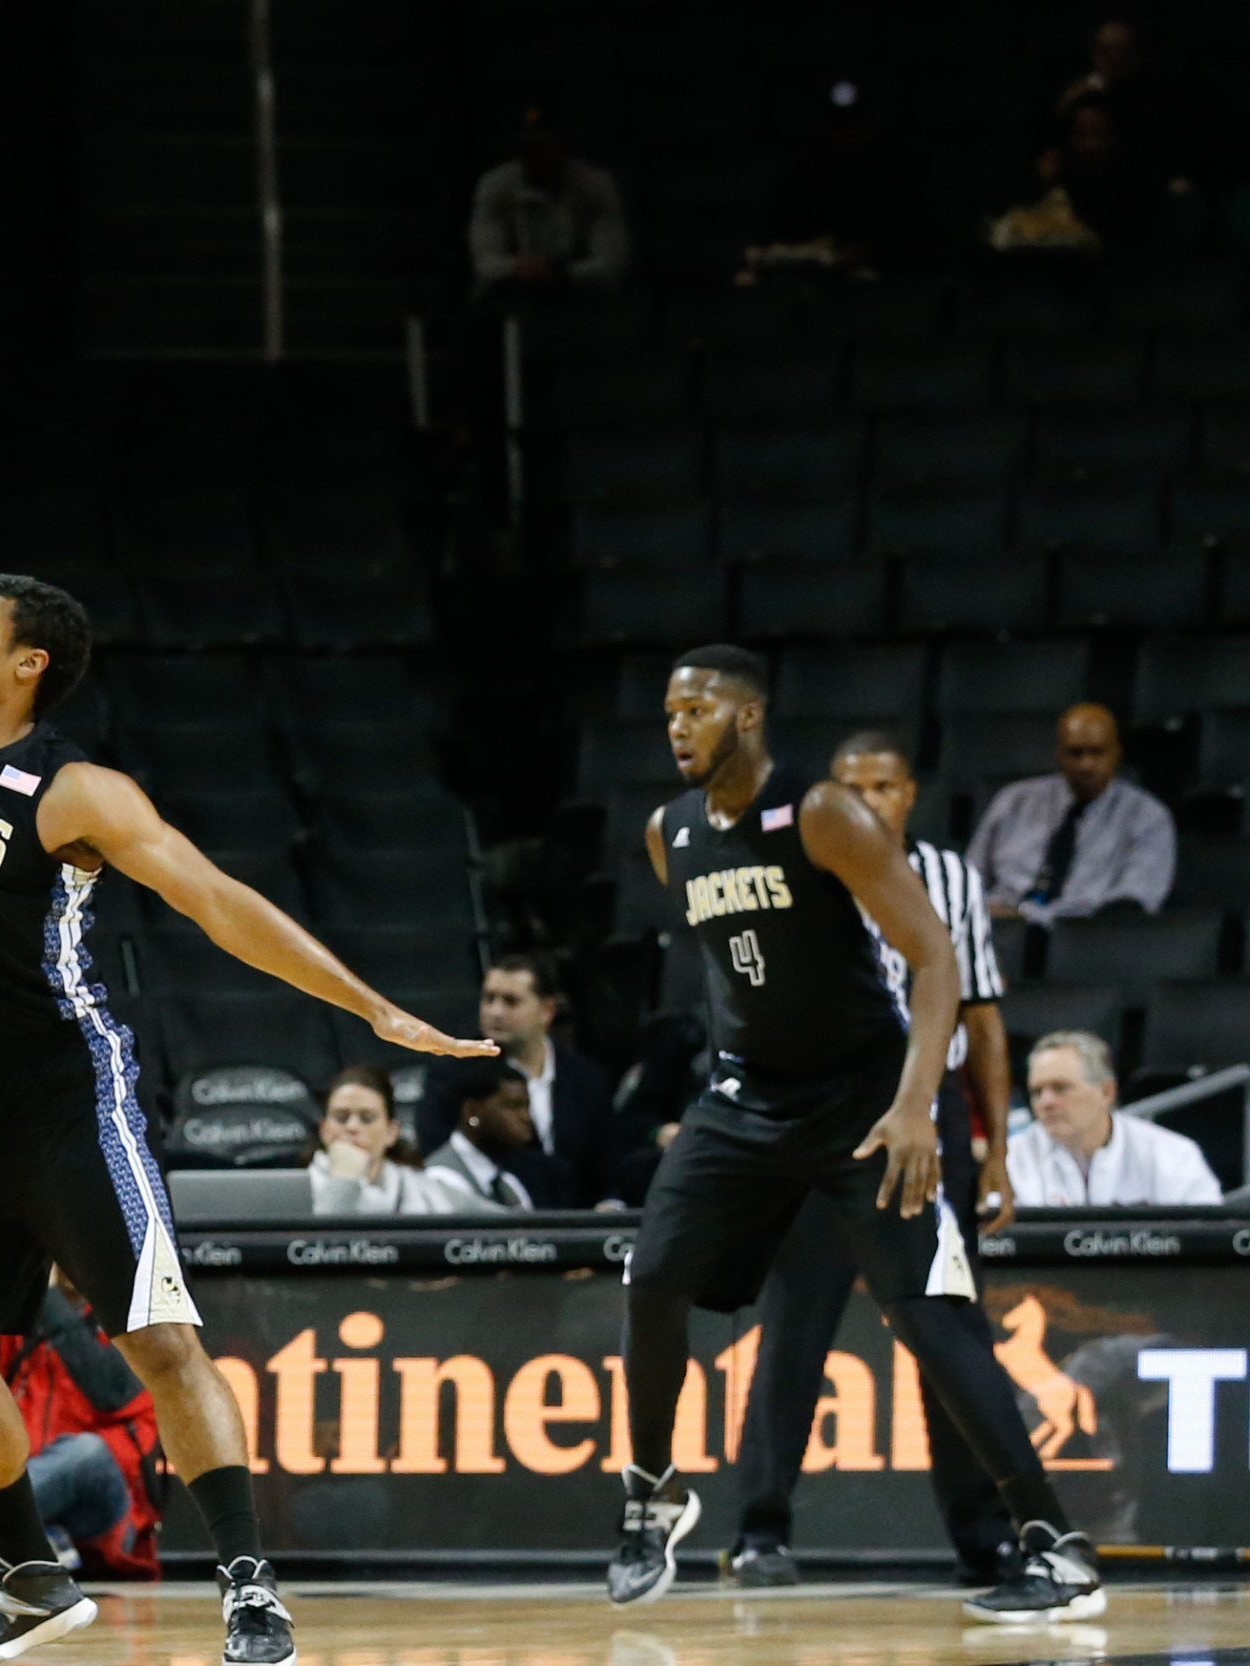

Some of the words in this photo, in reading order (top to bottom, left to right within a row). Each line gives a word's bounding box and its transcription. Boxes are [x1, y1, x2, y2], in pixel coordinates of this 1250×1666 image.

[685, 865, 794, 926] JACKETS
[729, 929, 766, 986] 4
[287, 1239, 349, 1266] Calvin
[444, 1238, 506, 1265] Calvin
[1064, 1229, 1129, 1257] Calvin
[1130, 1229, 1181, 1256] Klein
